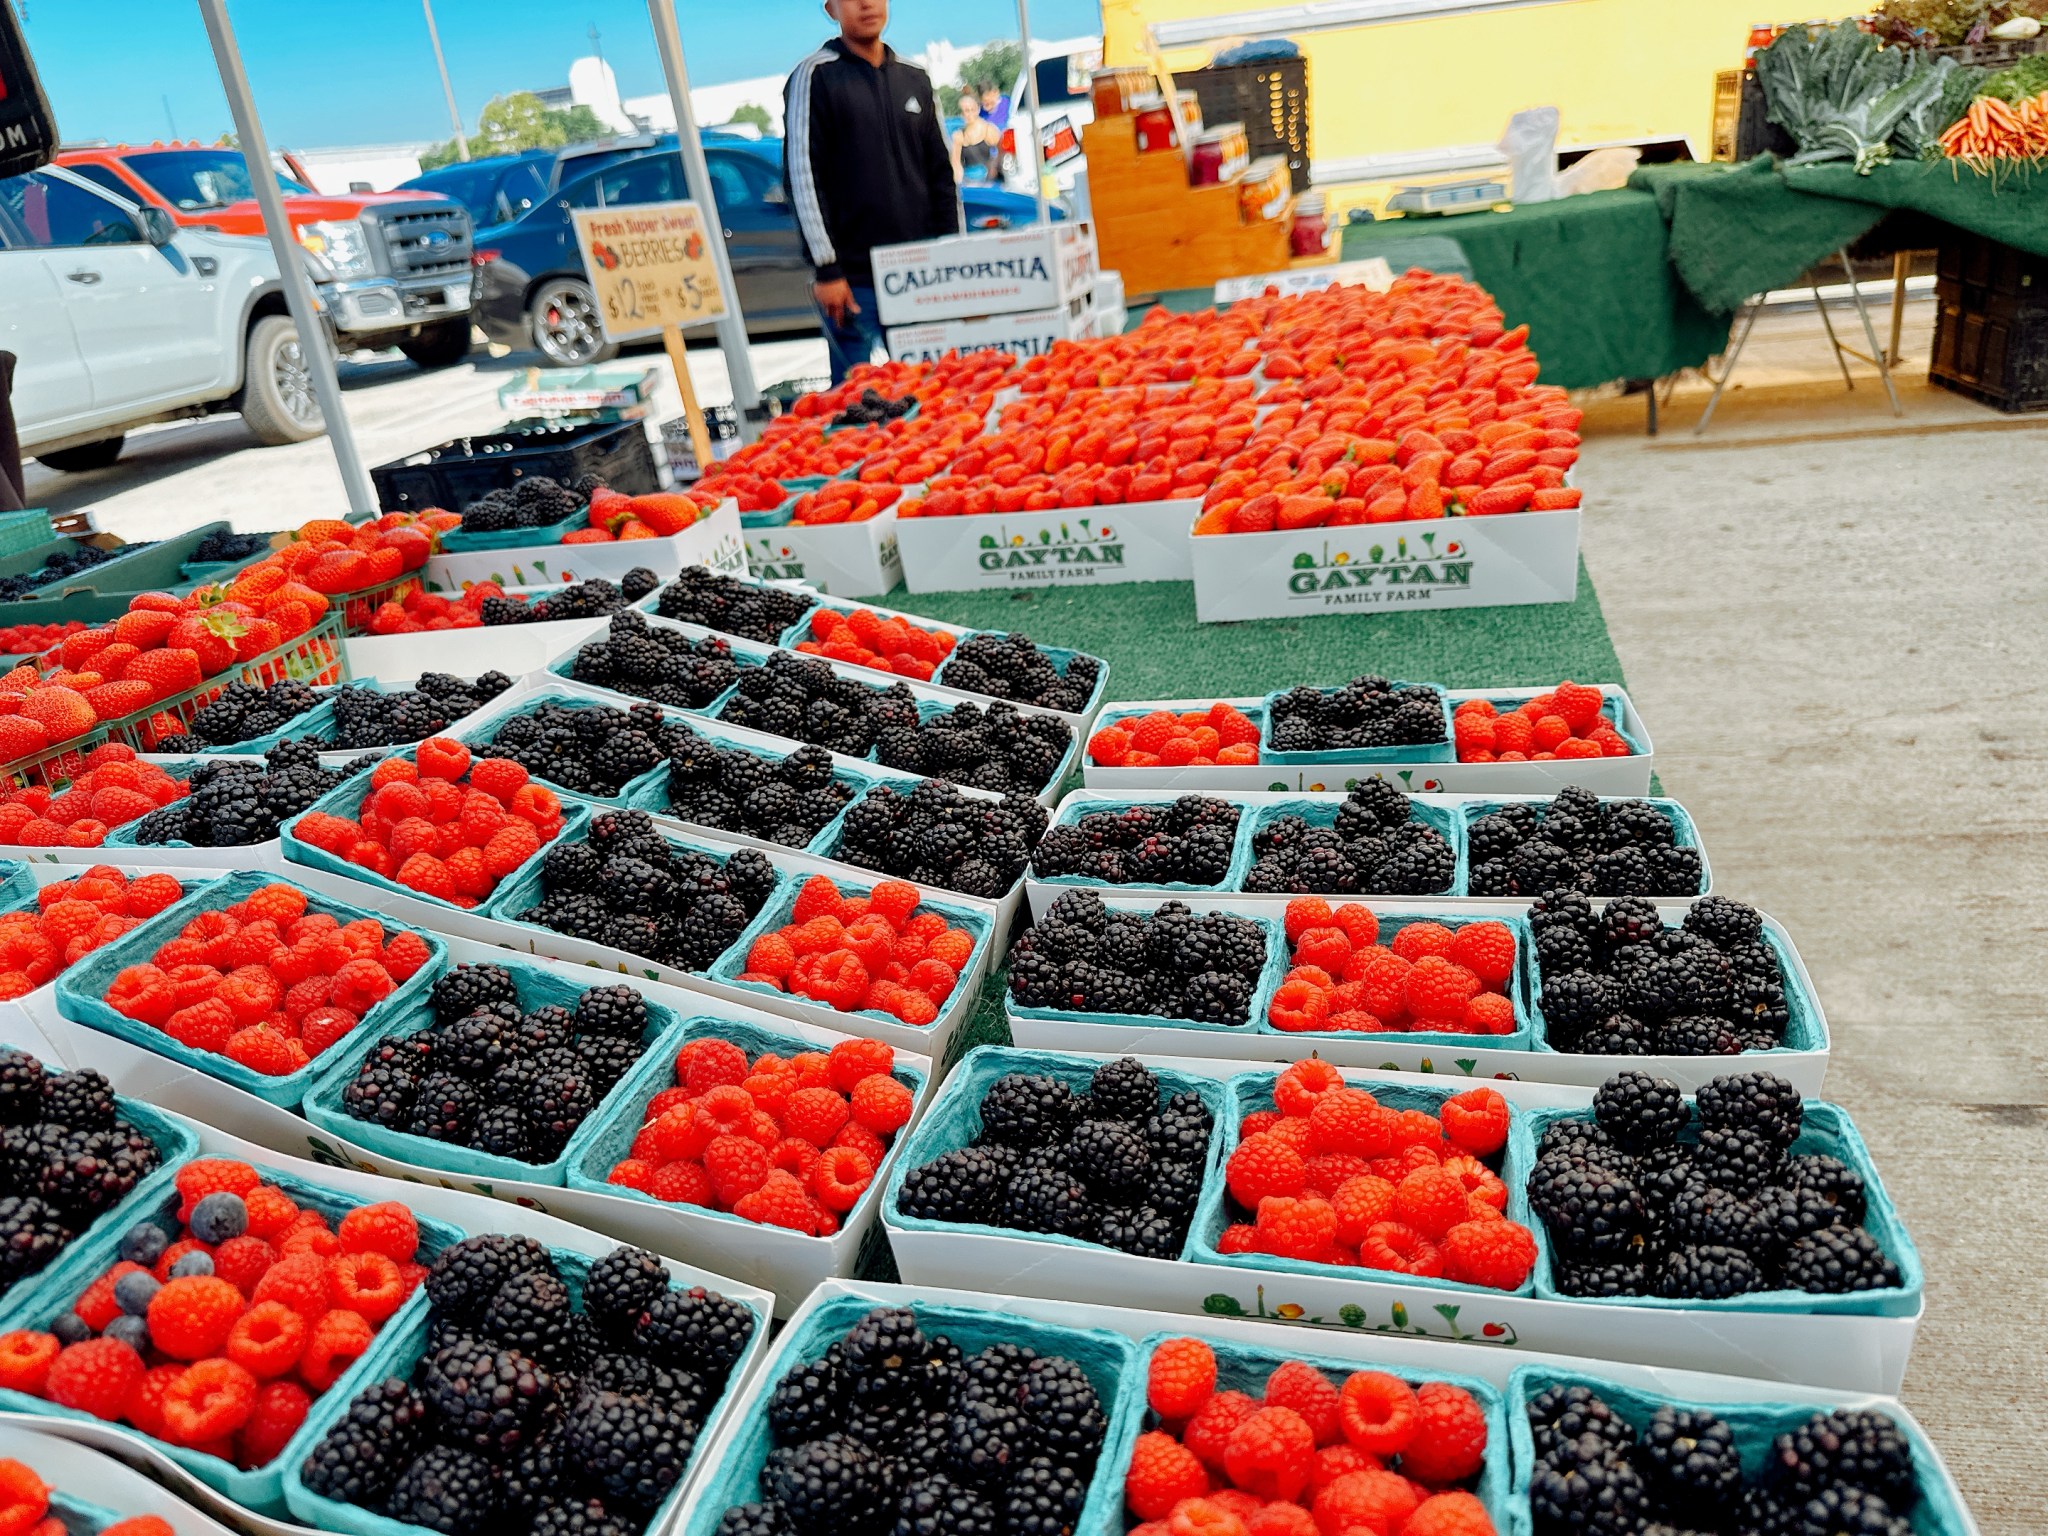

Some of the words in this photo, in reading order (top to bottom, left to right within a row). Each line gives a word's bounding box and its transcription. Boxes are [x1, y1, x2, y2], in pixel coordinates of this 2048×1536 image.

[589, 217, 625, 238] Fresh
[625, 216, 658, 236] Super
[661, 213, 695, 231] Sweet
[620, 238, 684, 269] BERRIES
[883, 256, 1050, 296] CALIFORNIA
[900, 336, 1055, 364] CALFORNIA
[978, 543, 1125, 571] GAYTAN
[1009, 570, 1056, 582] FAMILY
[1059, 568, 1096, 580] FARM
[1287, 561, 1474, 595] GAYTAN
[1324, 591, 1382, 606] FAMILY
[1387, 588, 1432, 602] FARM
